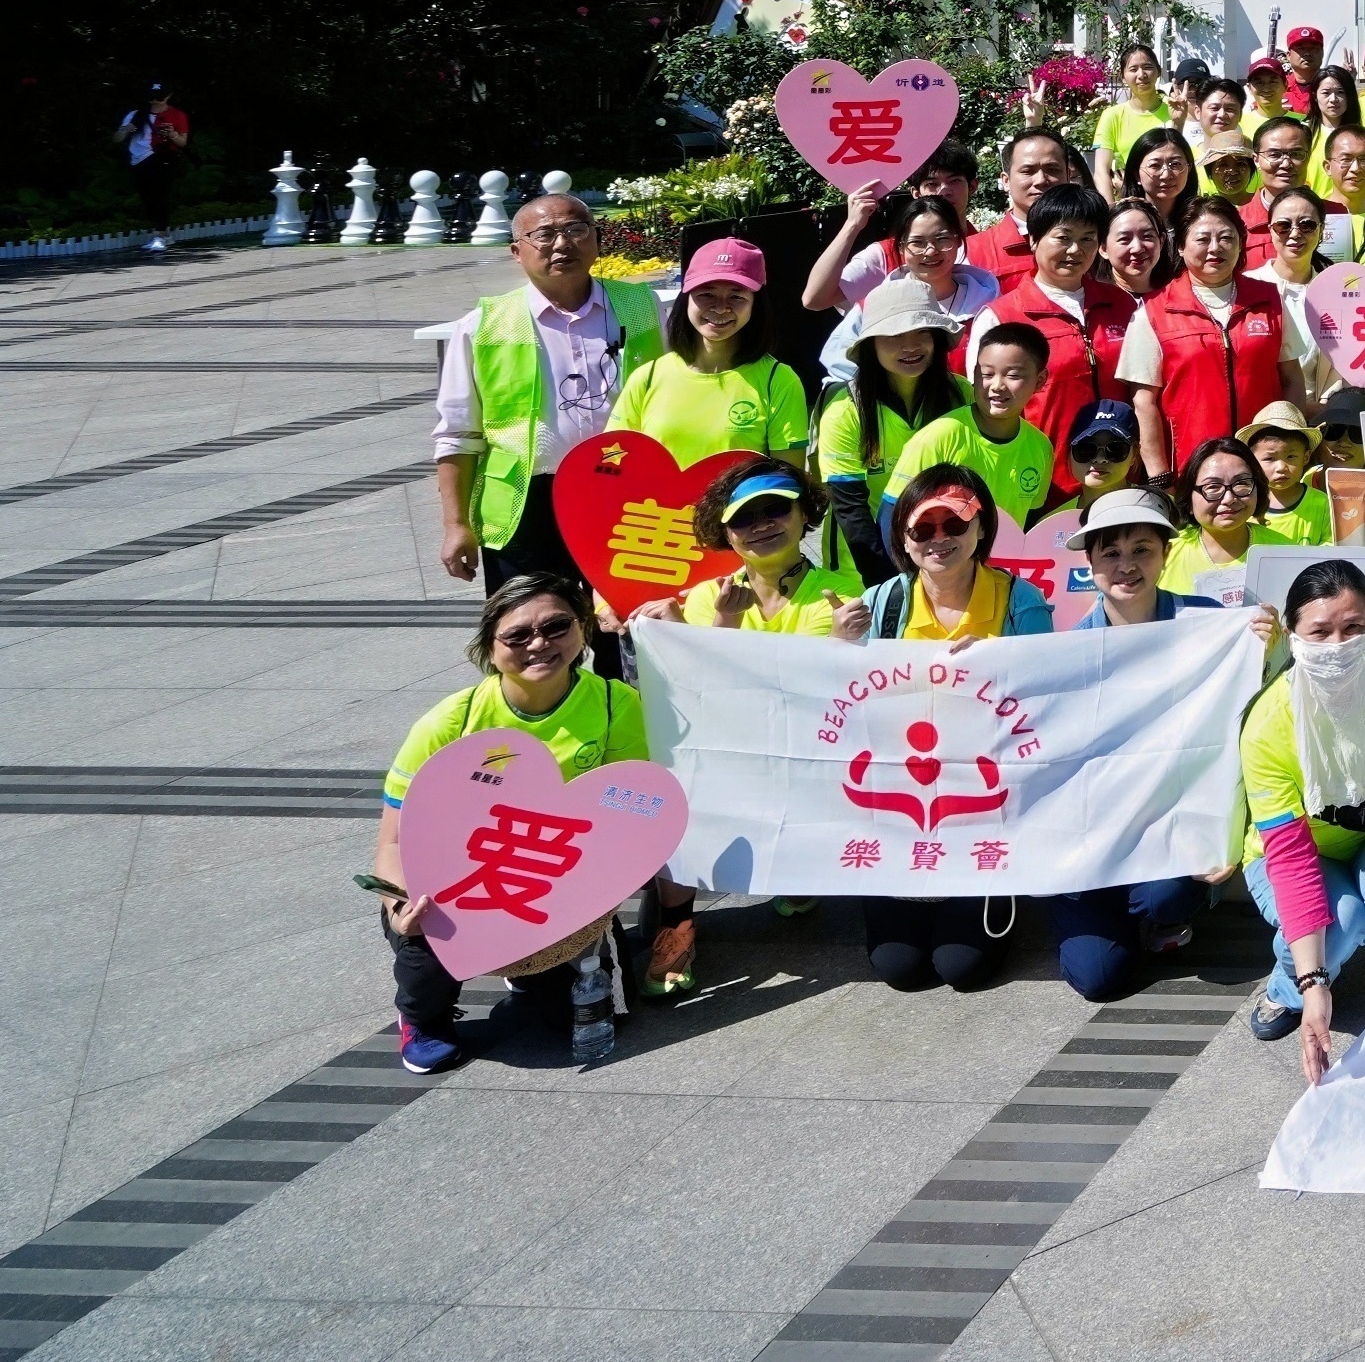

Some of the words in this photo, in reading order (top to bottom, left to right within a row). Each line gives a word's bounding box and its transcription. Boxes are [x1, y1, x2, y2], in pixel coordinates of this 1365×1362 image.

[826, 98, 904, 166] 爱
[607, 498, 704, 587] 善
[818, 663, 912, 744] BEACON
[929, 663, 969, 688] OF
[976, 679, 1041, 759] LOVE
[470, 770, 504, 786] 星星彩
[603, 785, 664, 810] 清济生物
[433, 803, 593, 926] 爱
[840, 839, 1008, 871] 樂賢薈
